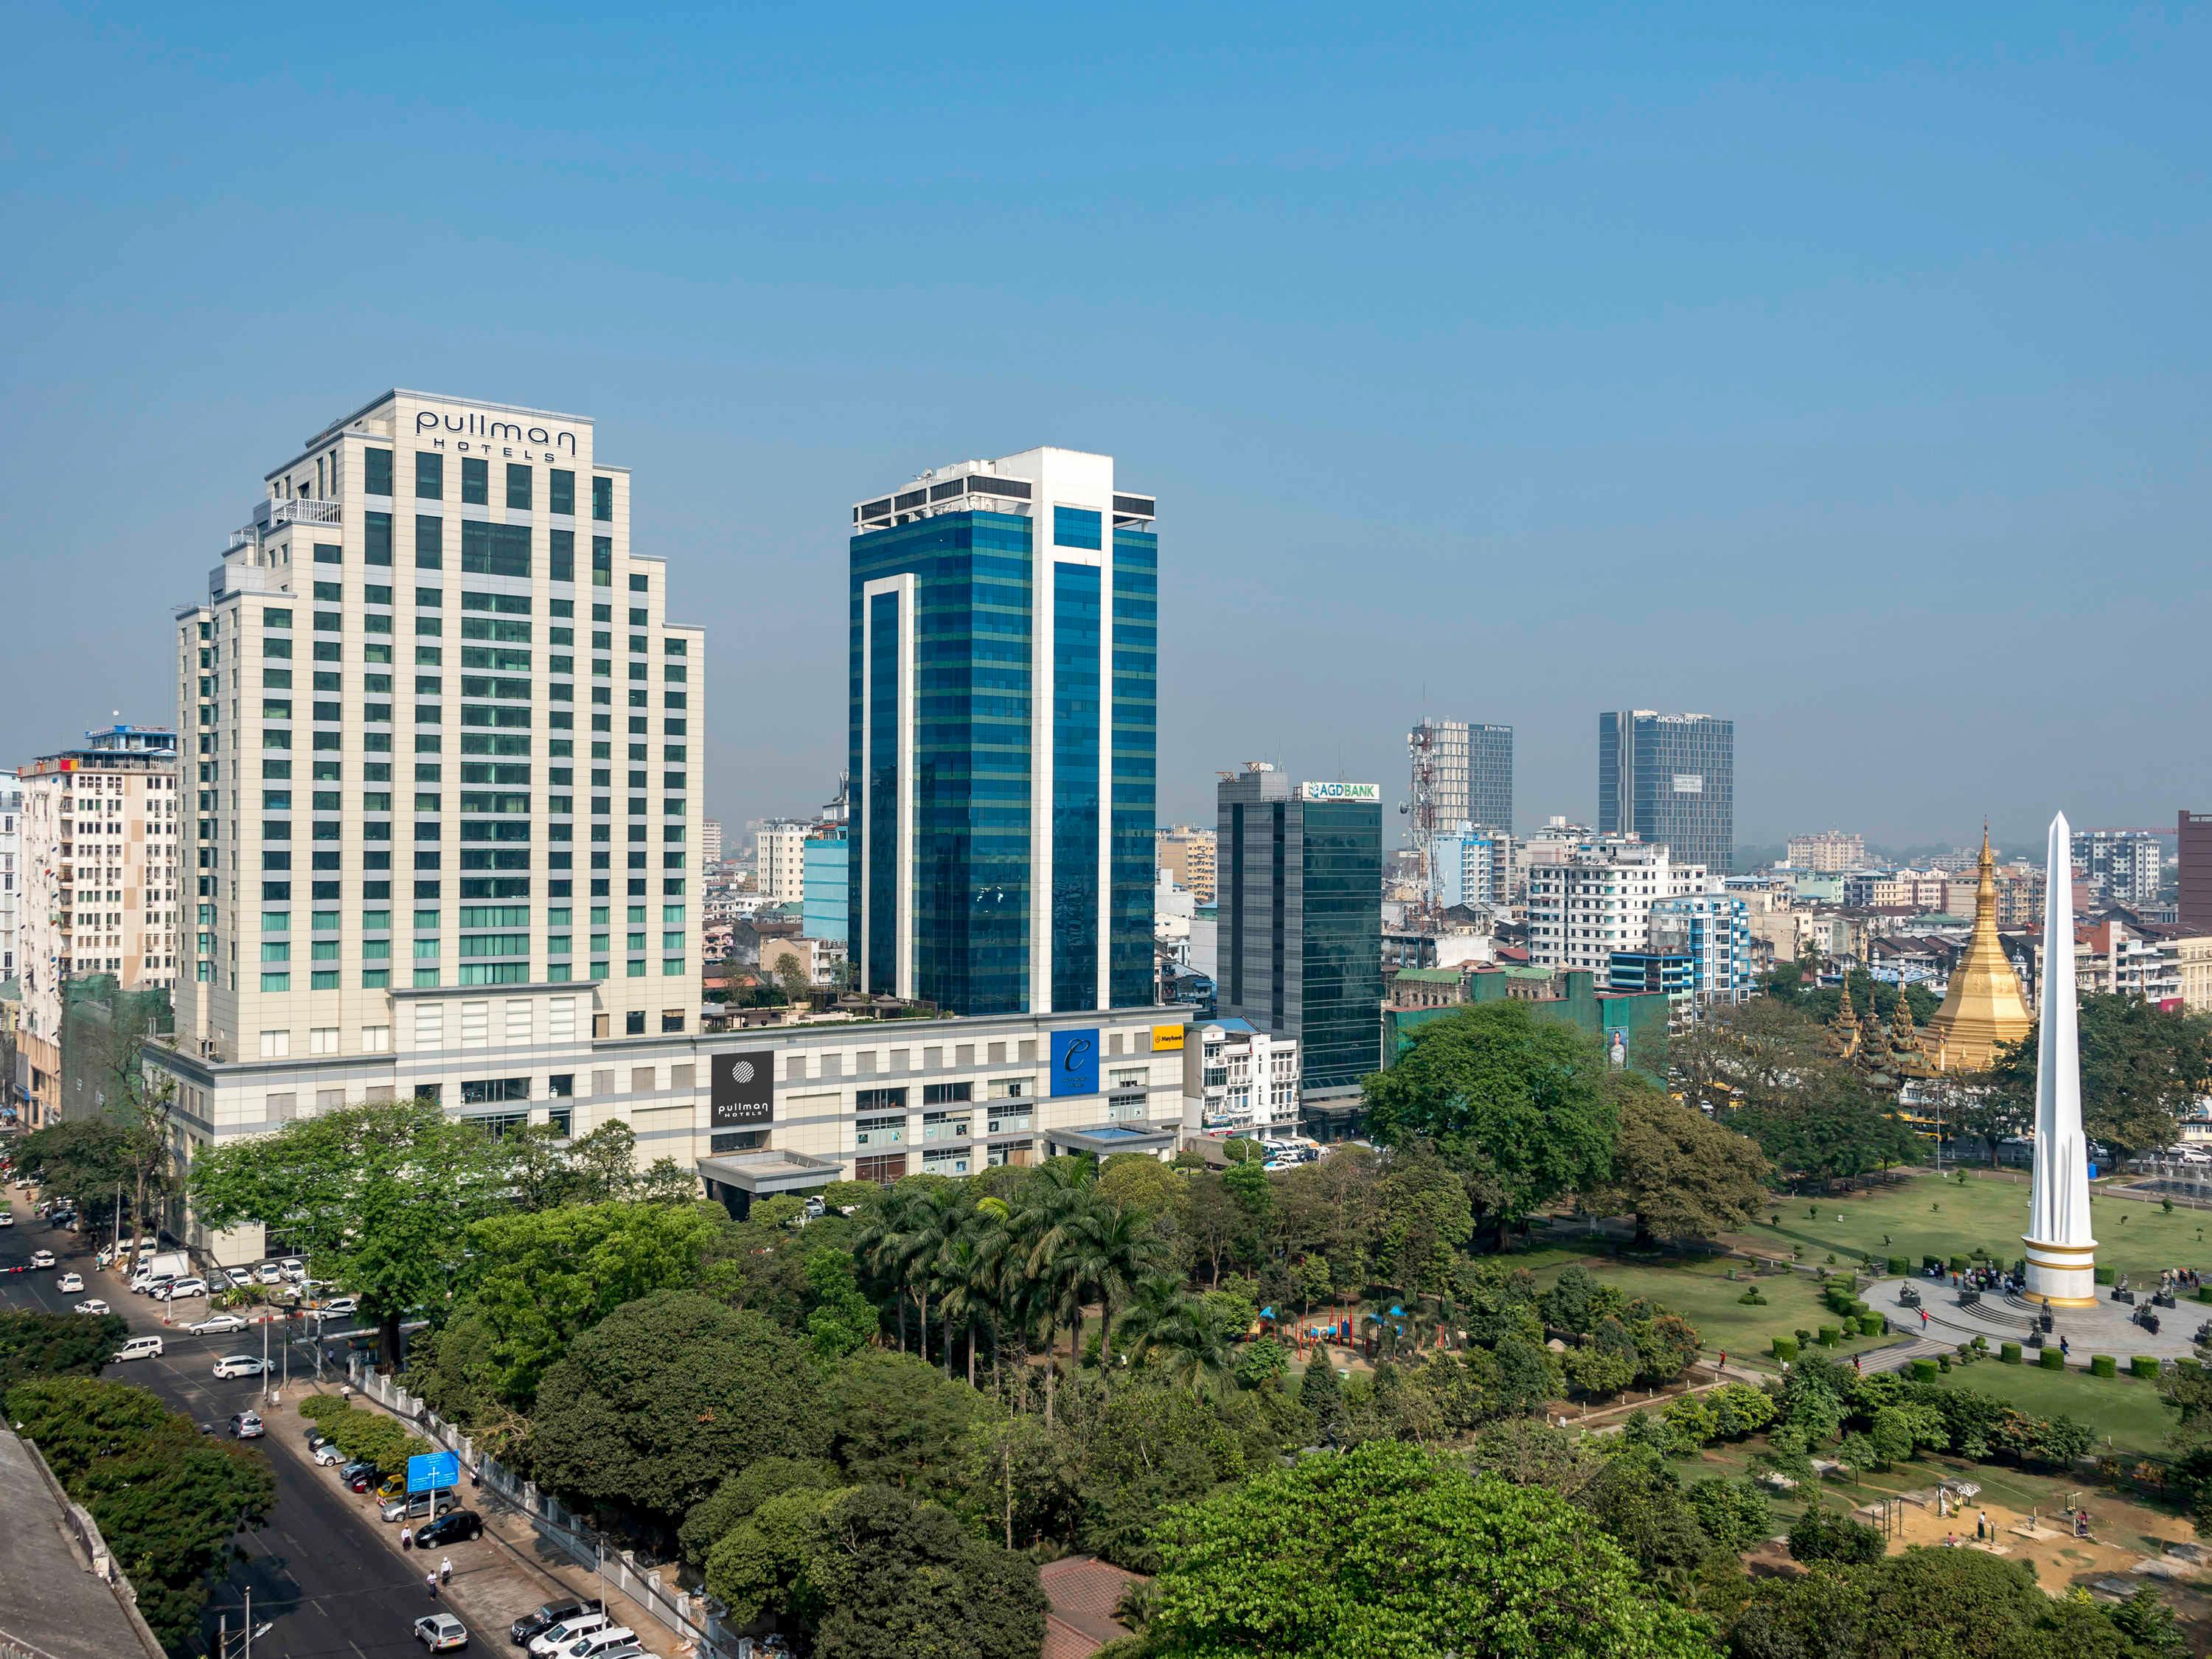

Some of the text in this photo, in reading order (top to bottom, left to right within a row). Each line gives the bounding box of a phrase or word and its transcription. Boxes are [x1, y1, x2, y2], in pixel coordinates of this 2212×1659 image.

[416, 411, 576, 456] pullman
[434, 438, 554, 462] HOTELS
[1656, 715, 1683, 724] JUNCTION
[1161, 1034, 1183, 1043] Maybank
[718, 1102, 768, 1115] pullman
